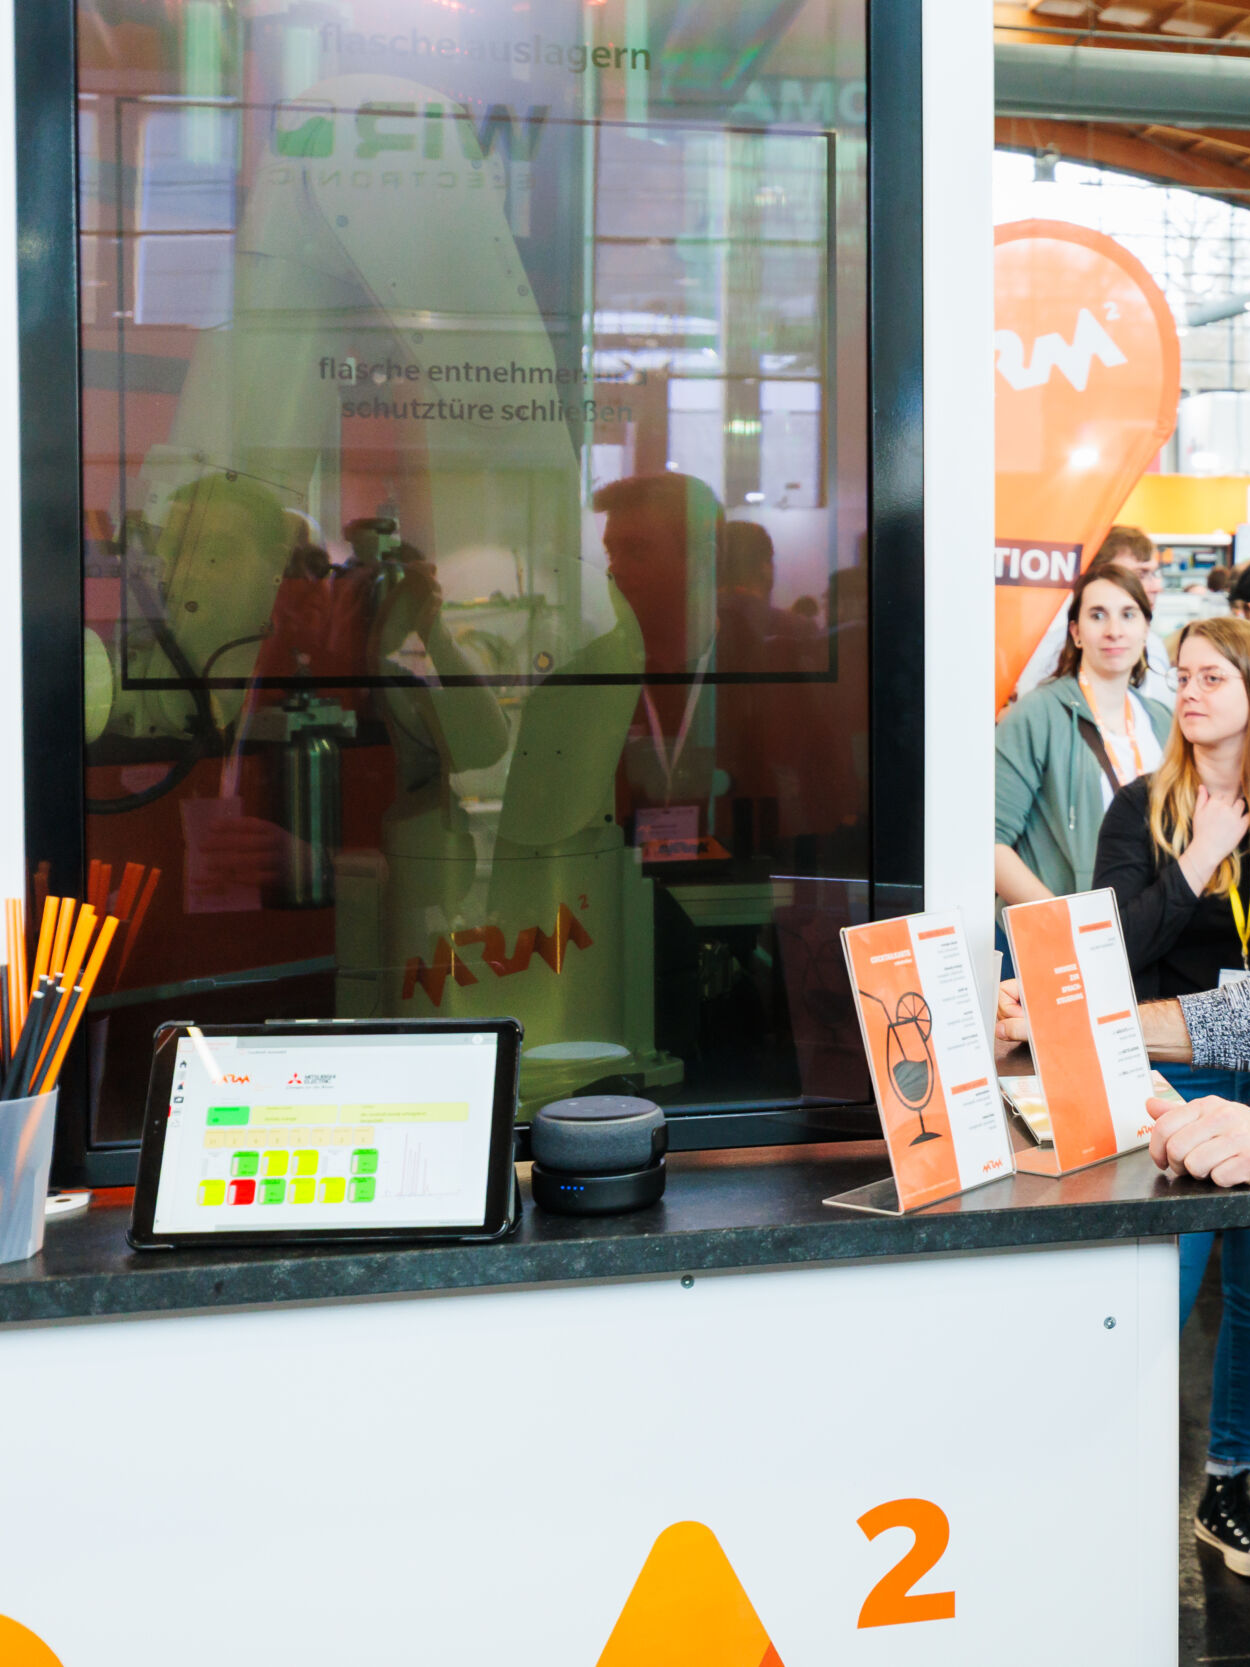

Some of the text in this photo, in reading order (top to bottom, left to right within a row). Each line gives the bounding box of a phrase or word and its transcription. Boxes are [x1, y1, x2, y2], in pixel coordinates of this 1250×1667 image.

[319, 357, 420, 382] flasche
[428, 361, 588, 385] entnehmen
[341, 397, 632, 423] schutztüre schließen
